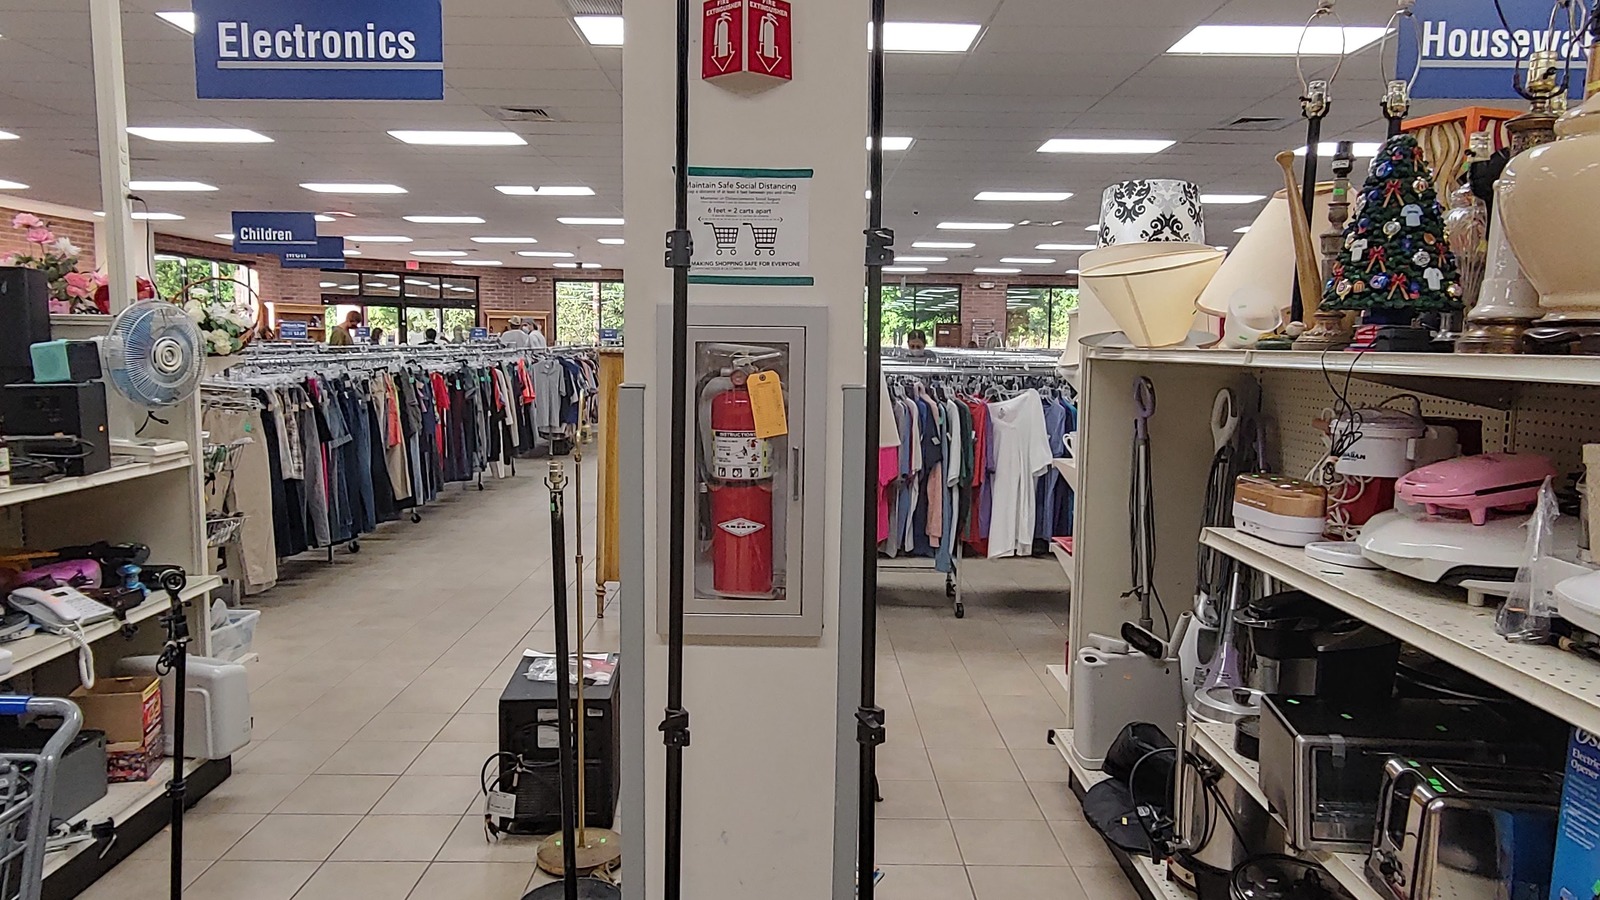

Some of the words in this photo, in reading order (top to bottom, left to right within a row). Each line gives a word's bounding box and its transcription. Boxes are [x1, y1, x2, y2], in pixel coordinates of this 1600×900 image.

[706, 1, 741, 17] EXTINGUISHER
[749, 1, 788, 17] EXTINGUISHER
[217, 21, 416, 60] Electronics
[718, 181, 734, 189] Safe
[736, 181, 757, 190] Social
[758, 182, 797, 191] Distancing
[240, 227, 292, 240] Children
[1570, 759, 1600, 780] Opener
